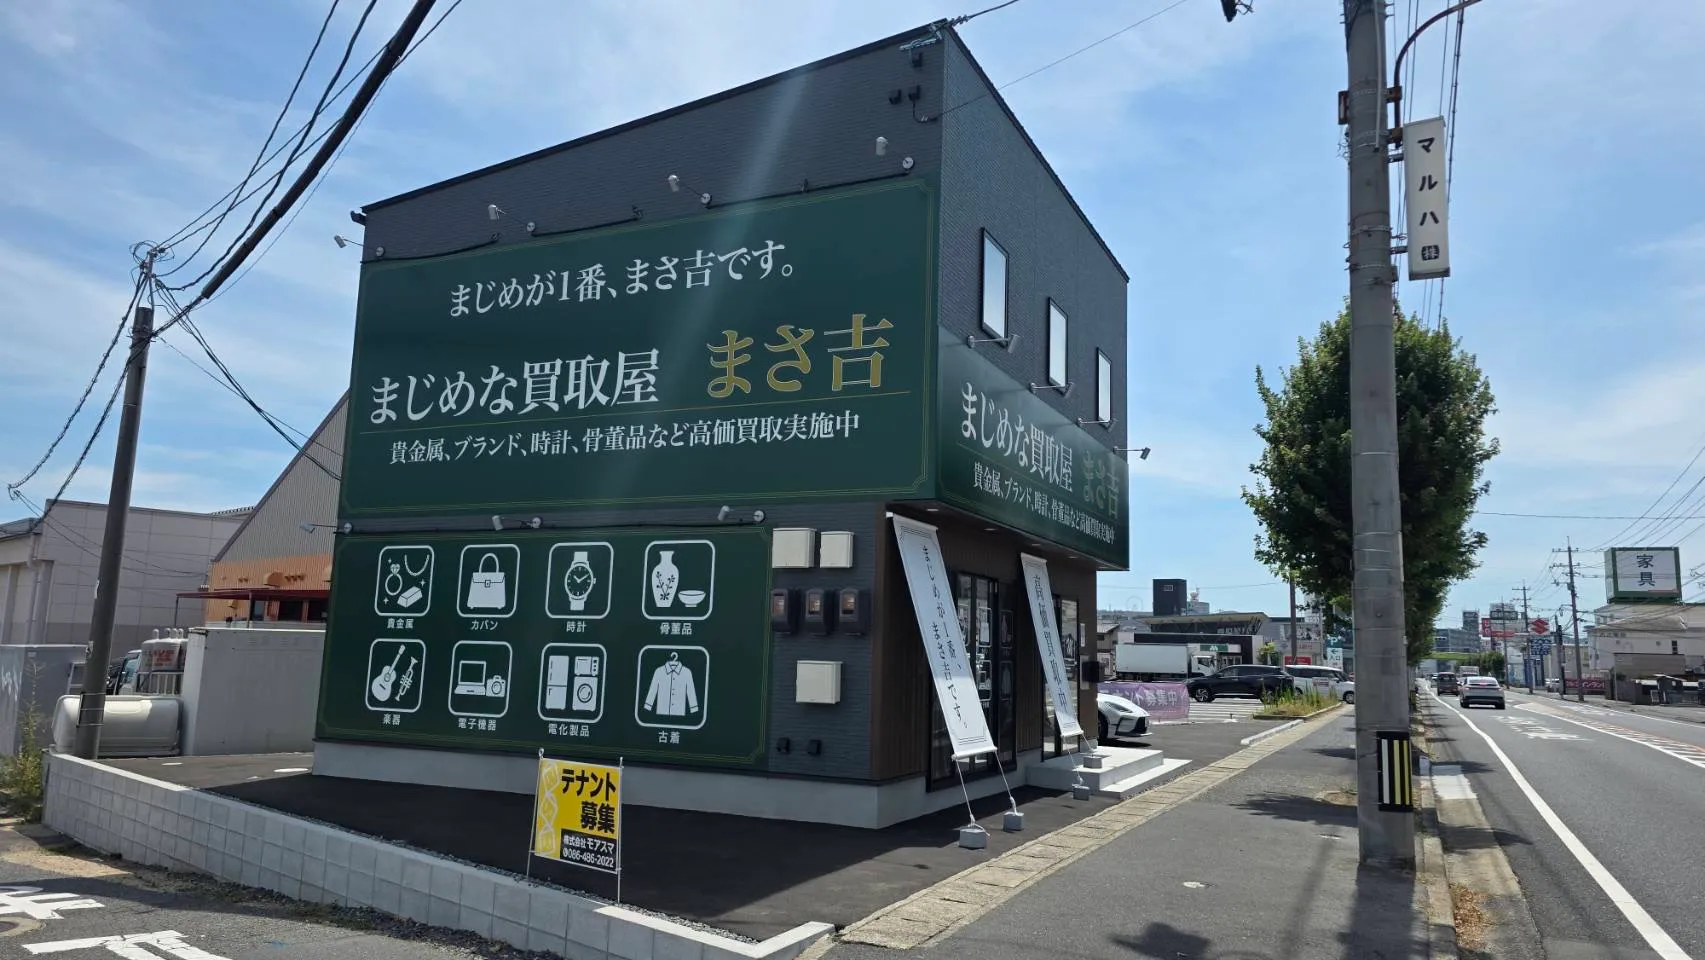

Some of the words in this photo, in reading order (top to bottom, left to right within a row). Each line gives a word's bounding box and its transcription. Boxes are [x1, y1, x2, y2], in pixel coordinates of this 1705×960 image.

[450, 240, 793, 317] まじめが1番、まさ吉です。
[370, 348, 660, 424] まじめな買取屋
[706, 313, 894, 398] まさ吉
[389, 410, 860, 465] 貴金属、ブランド、時計、骨董品など高価買取実施中
[961, 382, 1073, 493] まじめな買取屋
[1082, 449, 1120, 520] まさ吉
[1636, 554, 1656, 587] 家具
[386, 618, 414, 630] 貴金属
[470, 619, 499, 631] カバン
[565, 621, 587, 633] 時計
[659, 622, 693, 635] 骨董品
[382, 713, 401, 726] 楽器
[457, 718, 497, 732] 電子機器
[547, 723, 590, 738] 電化製品
[657, 731, 680, 744] 古着
[561, 768, 616, 801] テナント
[580, 800, 615, 834] 募集
[563, 834, 615, 855] 株式会社モアスマ
